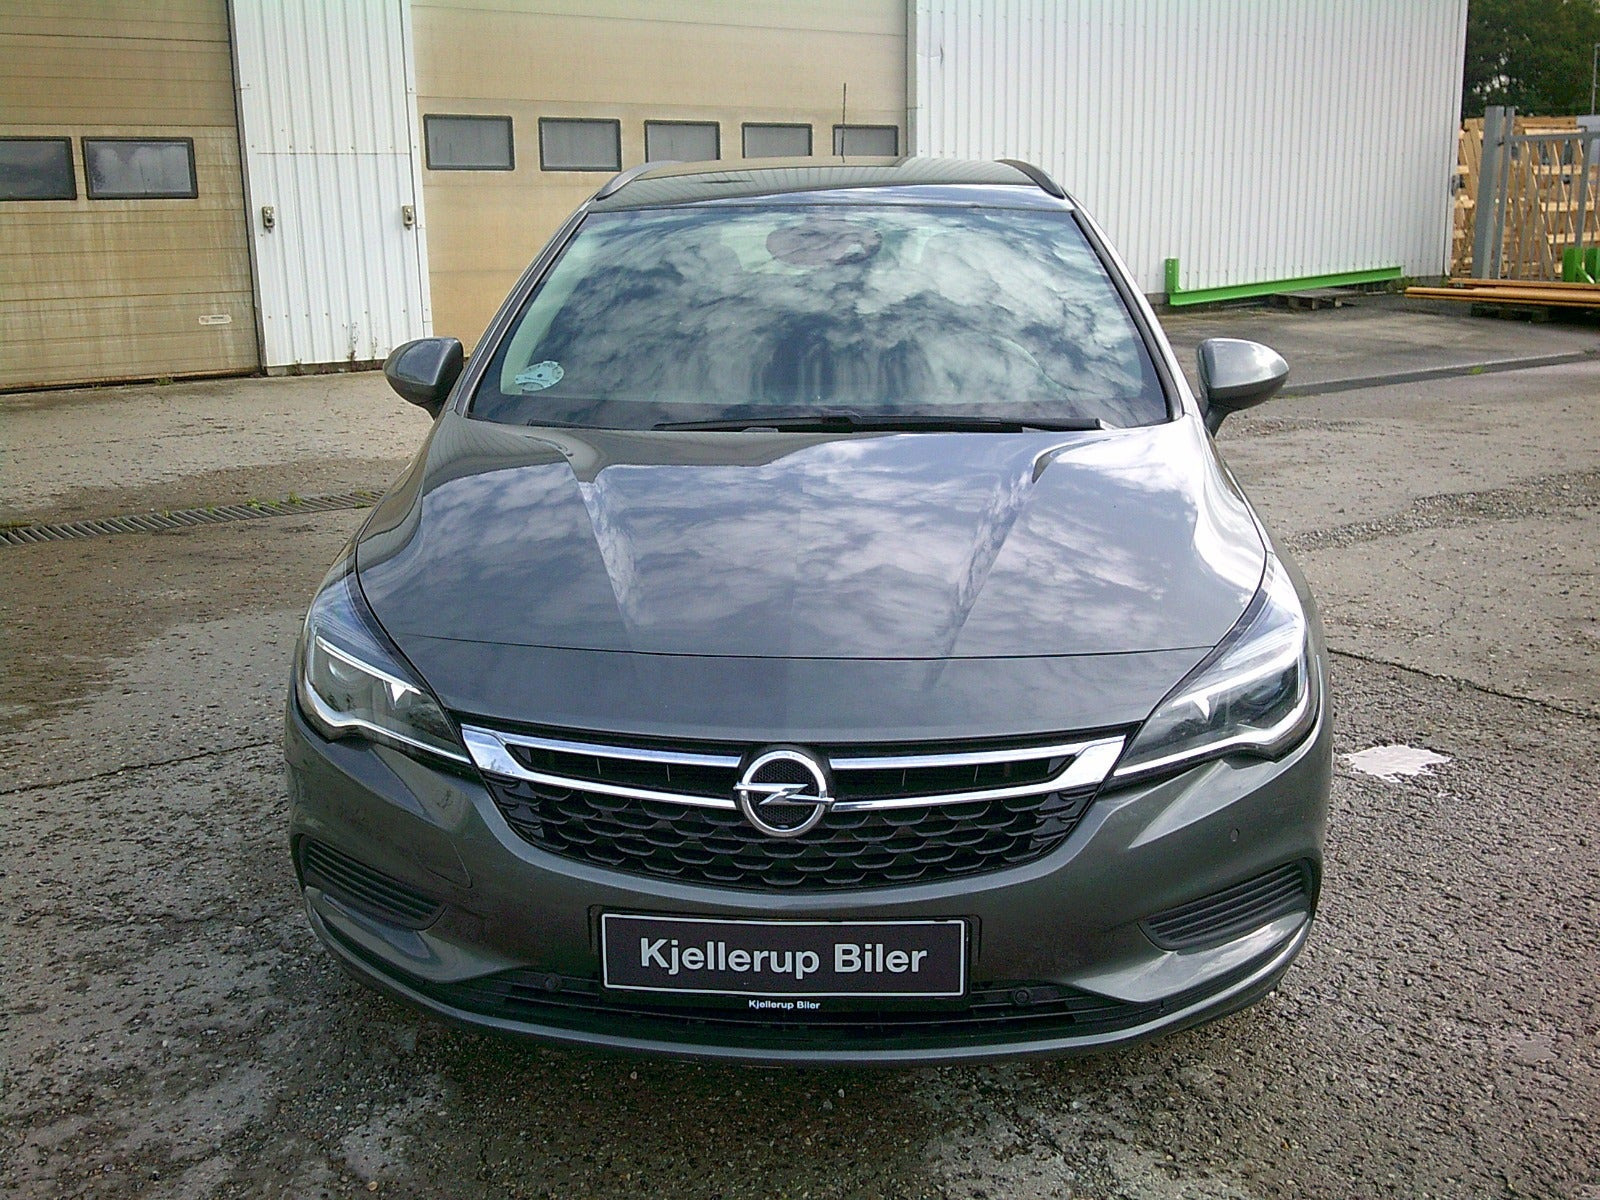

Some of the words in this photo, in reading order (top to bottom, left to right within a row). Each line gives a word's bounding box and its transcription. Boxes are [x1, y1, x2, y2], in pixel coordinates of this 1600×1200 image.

[640, 937, 820, 979] Kjellerup
[834, 943, 927, 973] Biler
[748, 999, 794, 1010] Kjellerup
[796, 1000, 820, 1010] Biler
